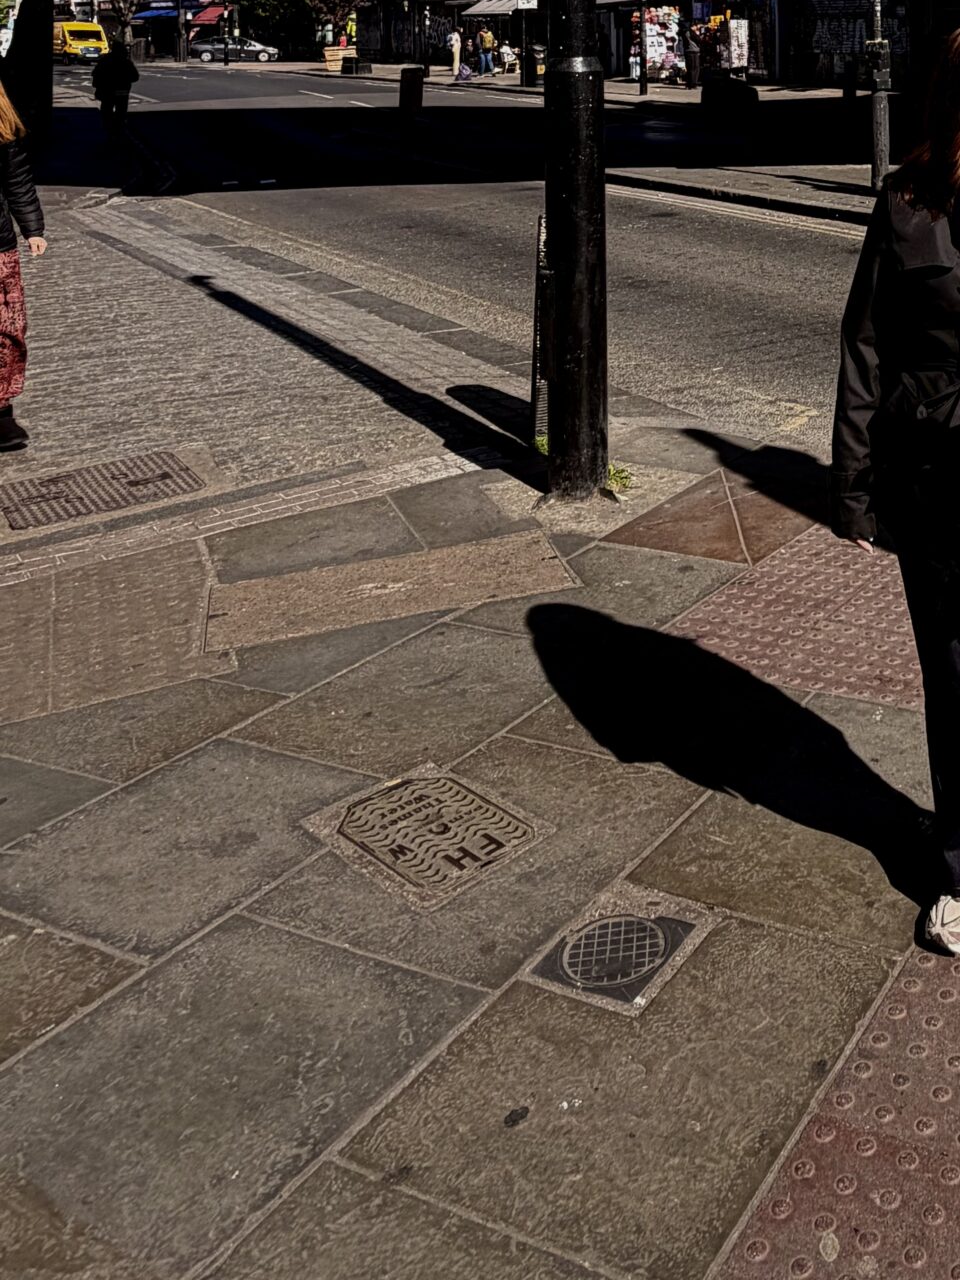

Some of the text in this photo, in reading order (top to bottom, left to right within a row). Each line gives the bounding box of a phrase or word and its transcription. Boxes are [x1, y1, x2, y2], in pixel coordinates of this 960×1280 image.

[377, 793, 432, 820] Water
[377, 797, 447, 831] Thames
[443, 832, 507, 872] FH
